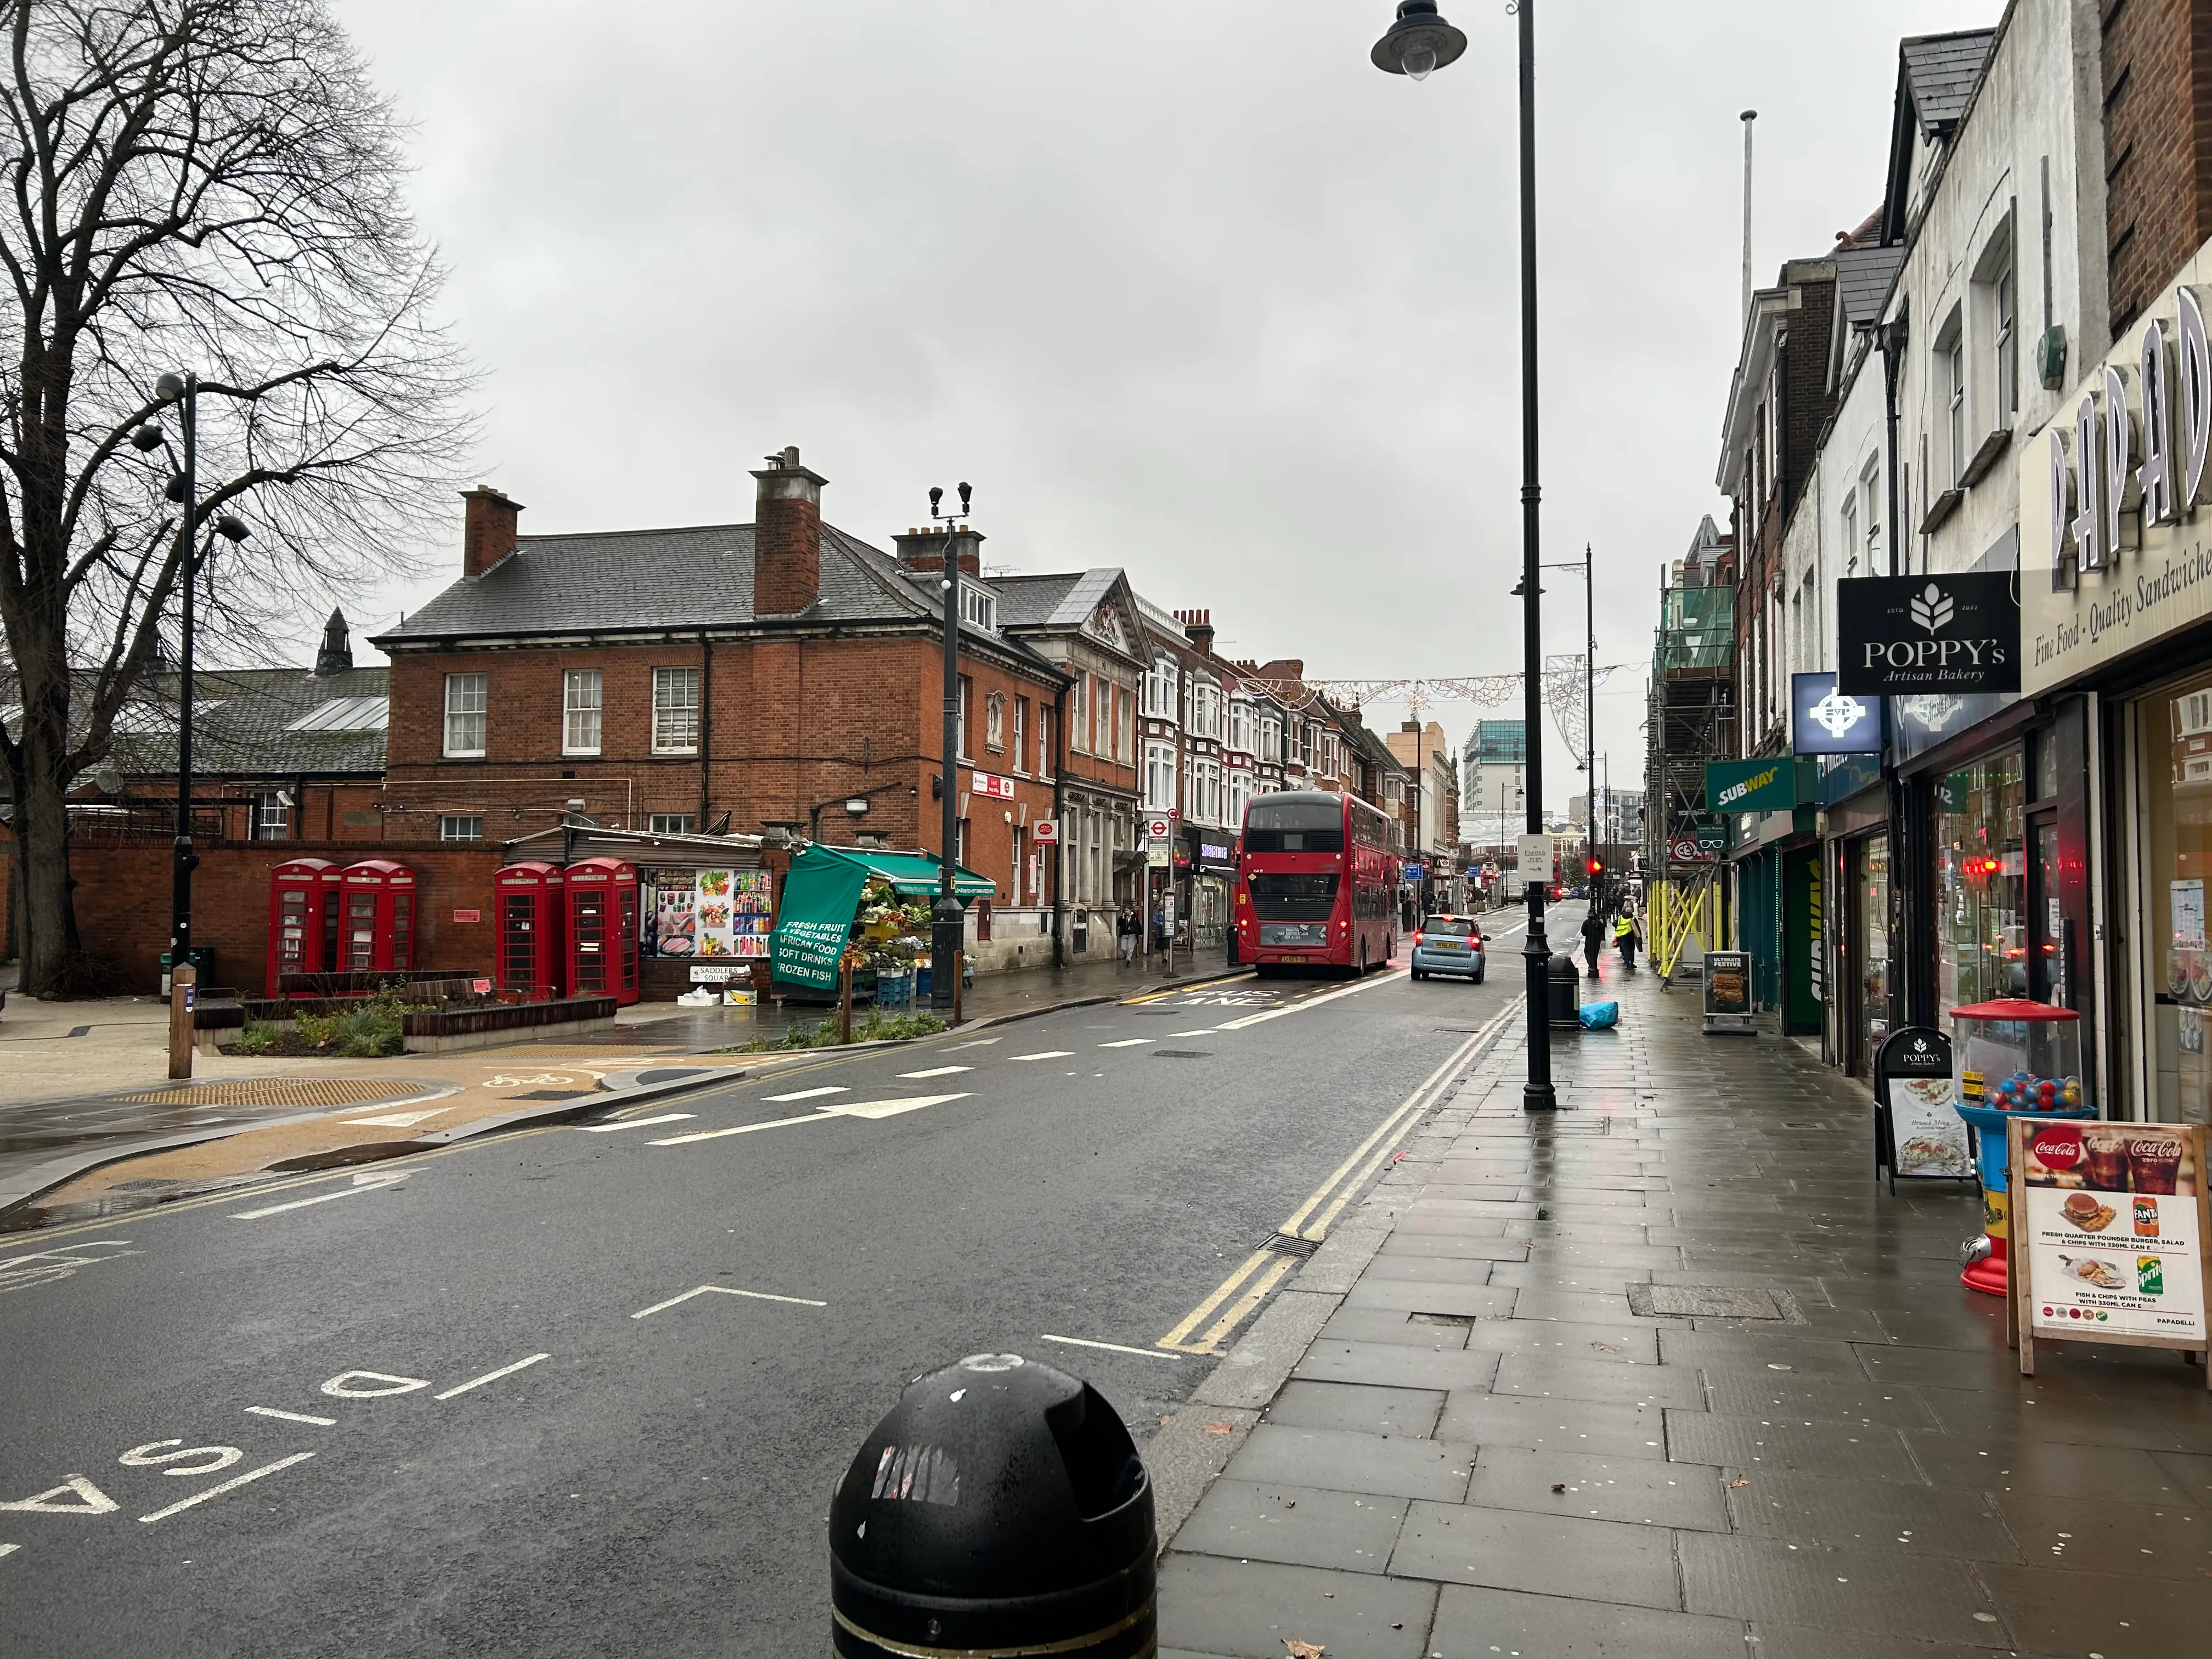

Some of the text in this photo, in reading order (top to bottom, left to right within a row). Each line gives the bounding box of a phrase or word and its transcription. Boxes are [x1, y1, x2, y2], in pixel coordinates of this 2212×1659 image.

[2035, 634, 2055, 667] Fine
[2056, 612, 2080, 656] Food
[2090, 588, 2132, 644] Quality
[1863, 639, 2005, 668] POPPY's
[1883, 669, 1984, 682] Artisan Bakery
[1718, 766, 1779, 806] SUBWAY
[786, 922, 847, 932] FRESH FRUIT
[790, 928, 842, 943] VEGETABLES
[813, 943, 837, 955] FOOD
[801, 952, 833, 966] DRINKS
[811, 967, 832, 981] FISH
[1138, 997, 1276, 1006] LANE
[1903, 1054, 1940, 1062] POPPY's
[2035, 1142, 2076, 1155] Coca-Cola
[2157, 1318, 2195, 1326] PAPADELLI
